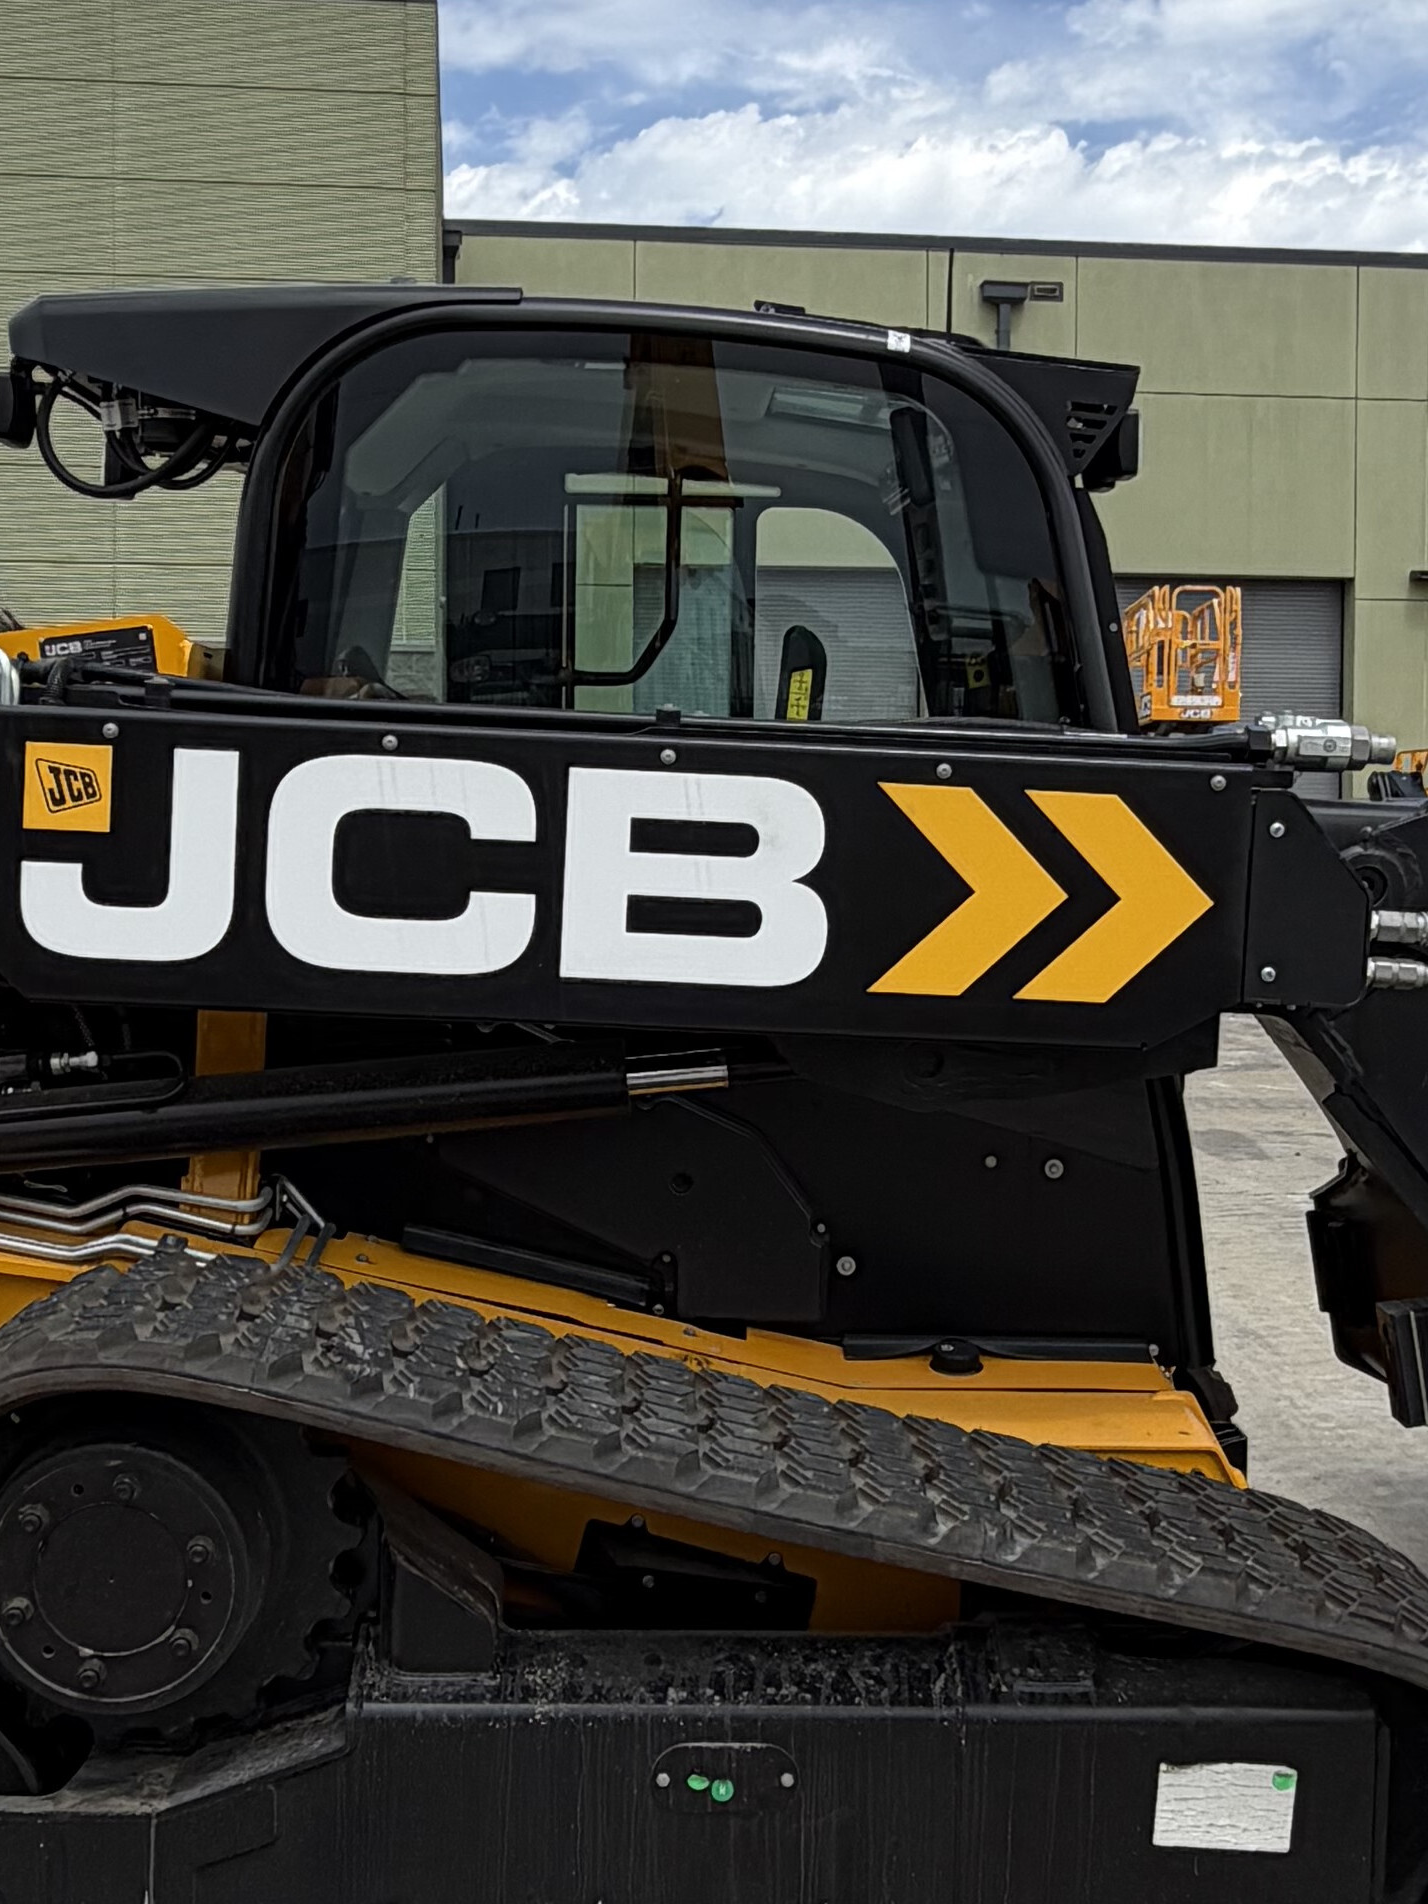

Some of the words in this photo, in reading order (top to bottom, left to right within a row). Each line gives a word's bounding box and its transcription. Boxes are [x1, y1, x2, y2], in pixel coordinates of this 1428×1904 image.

[44, 641, 82, 656] JCB
[47, 765, 98, 807] JCB
[20, 748, 828, 986] JCB
